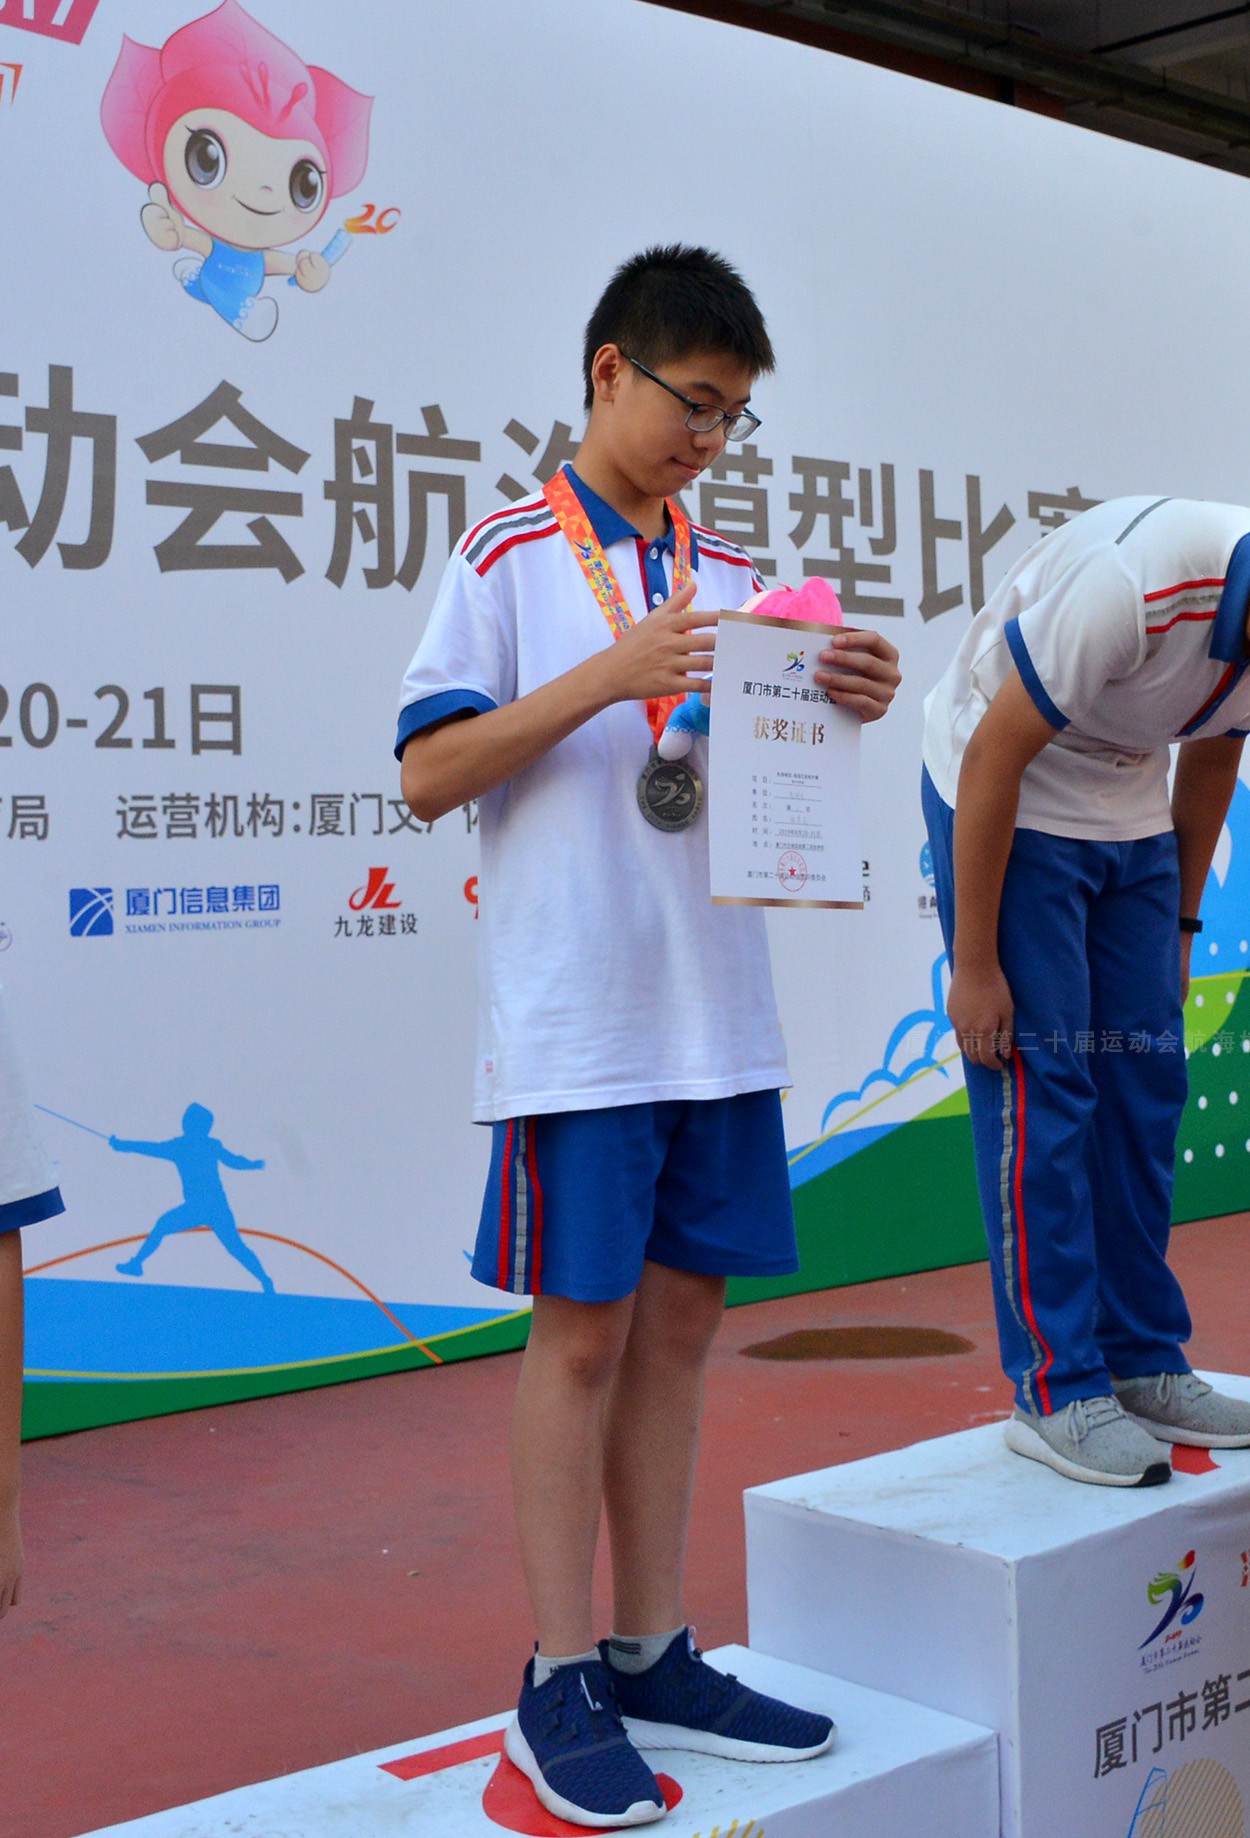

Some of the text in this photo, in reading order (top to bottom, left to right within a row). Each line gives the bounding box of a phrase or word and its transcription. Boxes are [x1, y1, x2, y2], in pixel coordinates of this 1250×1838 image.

[753, 716, 826, 746] 获奖证书
[125, 884, 281, 916] 厦门信息集团
[125, 918, 282, 934] XIAMEN INFORMATION GROUP
[333, 913, 419, 940] 九龙建设
